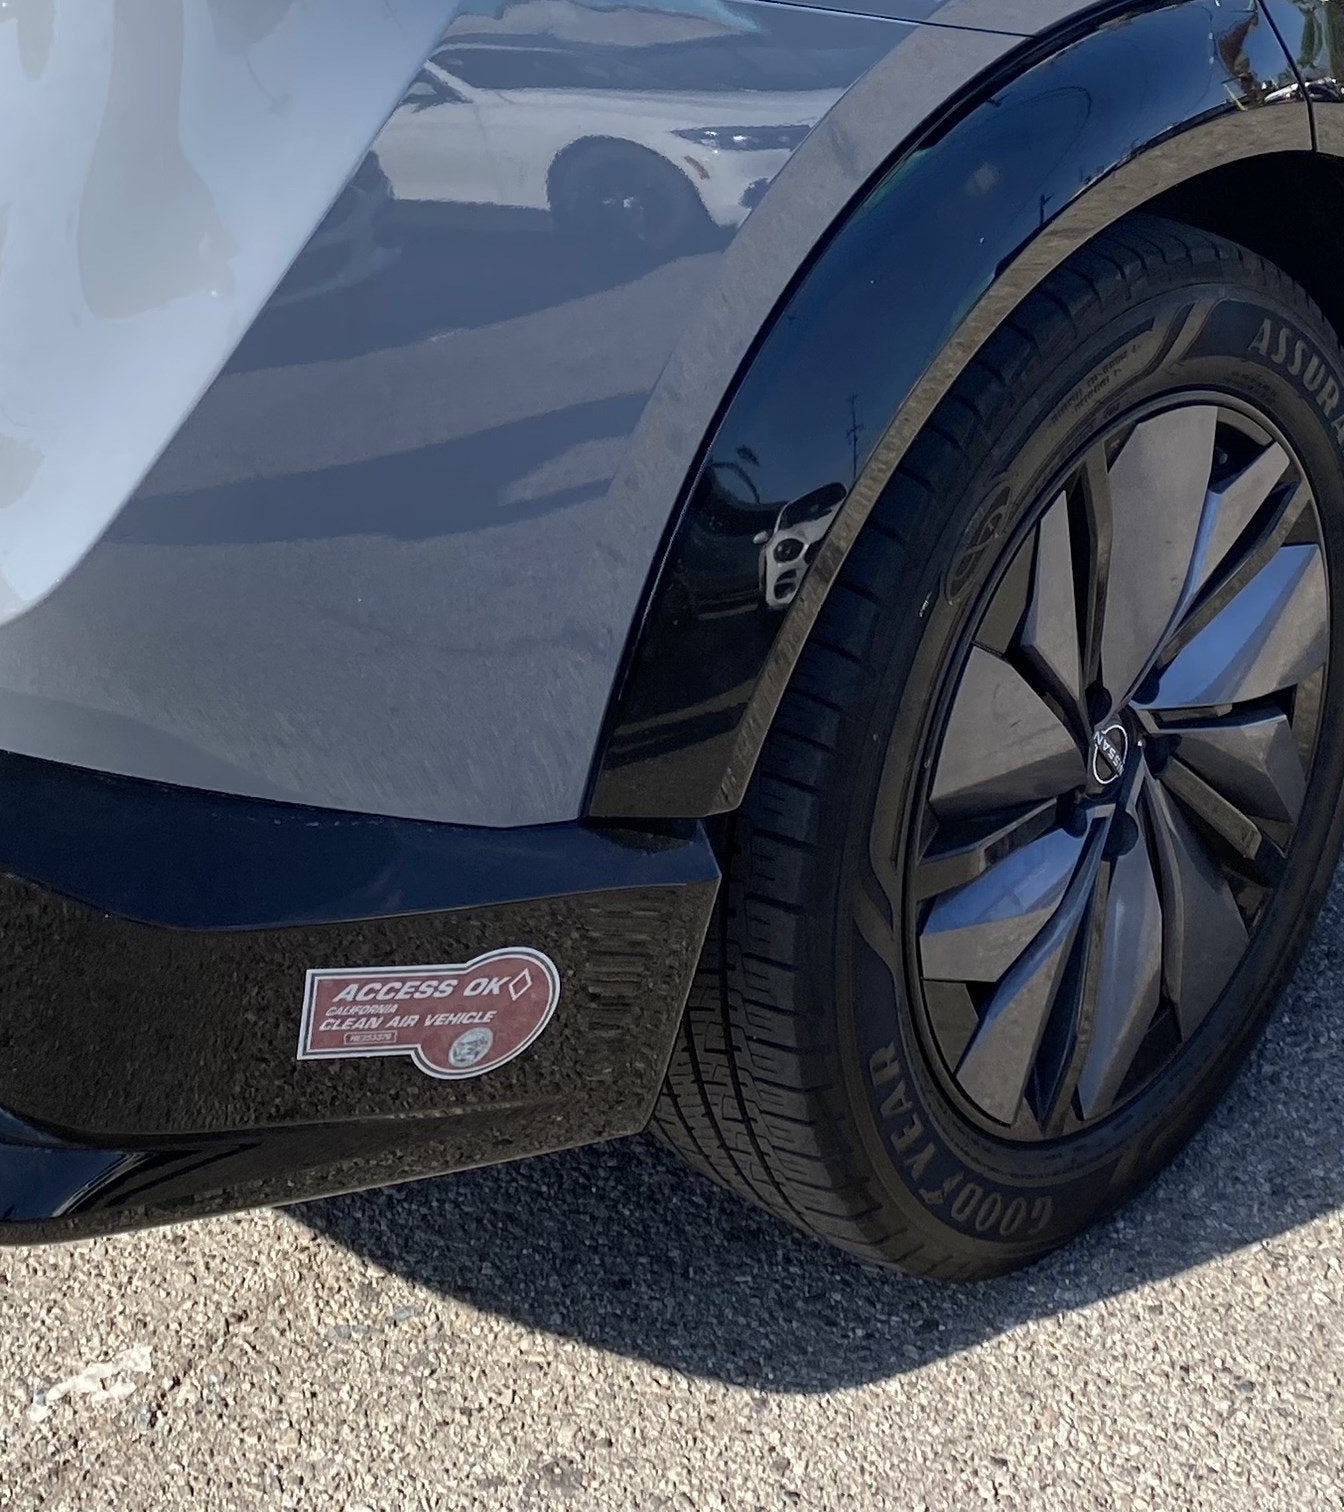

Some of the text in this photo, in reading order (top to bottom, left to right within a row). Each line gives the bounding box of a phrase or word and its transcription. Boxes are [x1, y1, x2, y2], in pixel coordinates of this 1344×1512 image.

[331, 975, 512, 1003] ACCESS OK
[318, 1010, 498, 1032] CLEAN AIR VEHICLE
[325, 1003, 398, 1017] CALIFORNIA
[868, 1041, 1055, 1237] GOODYEAR
